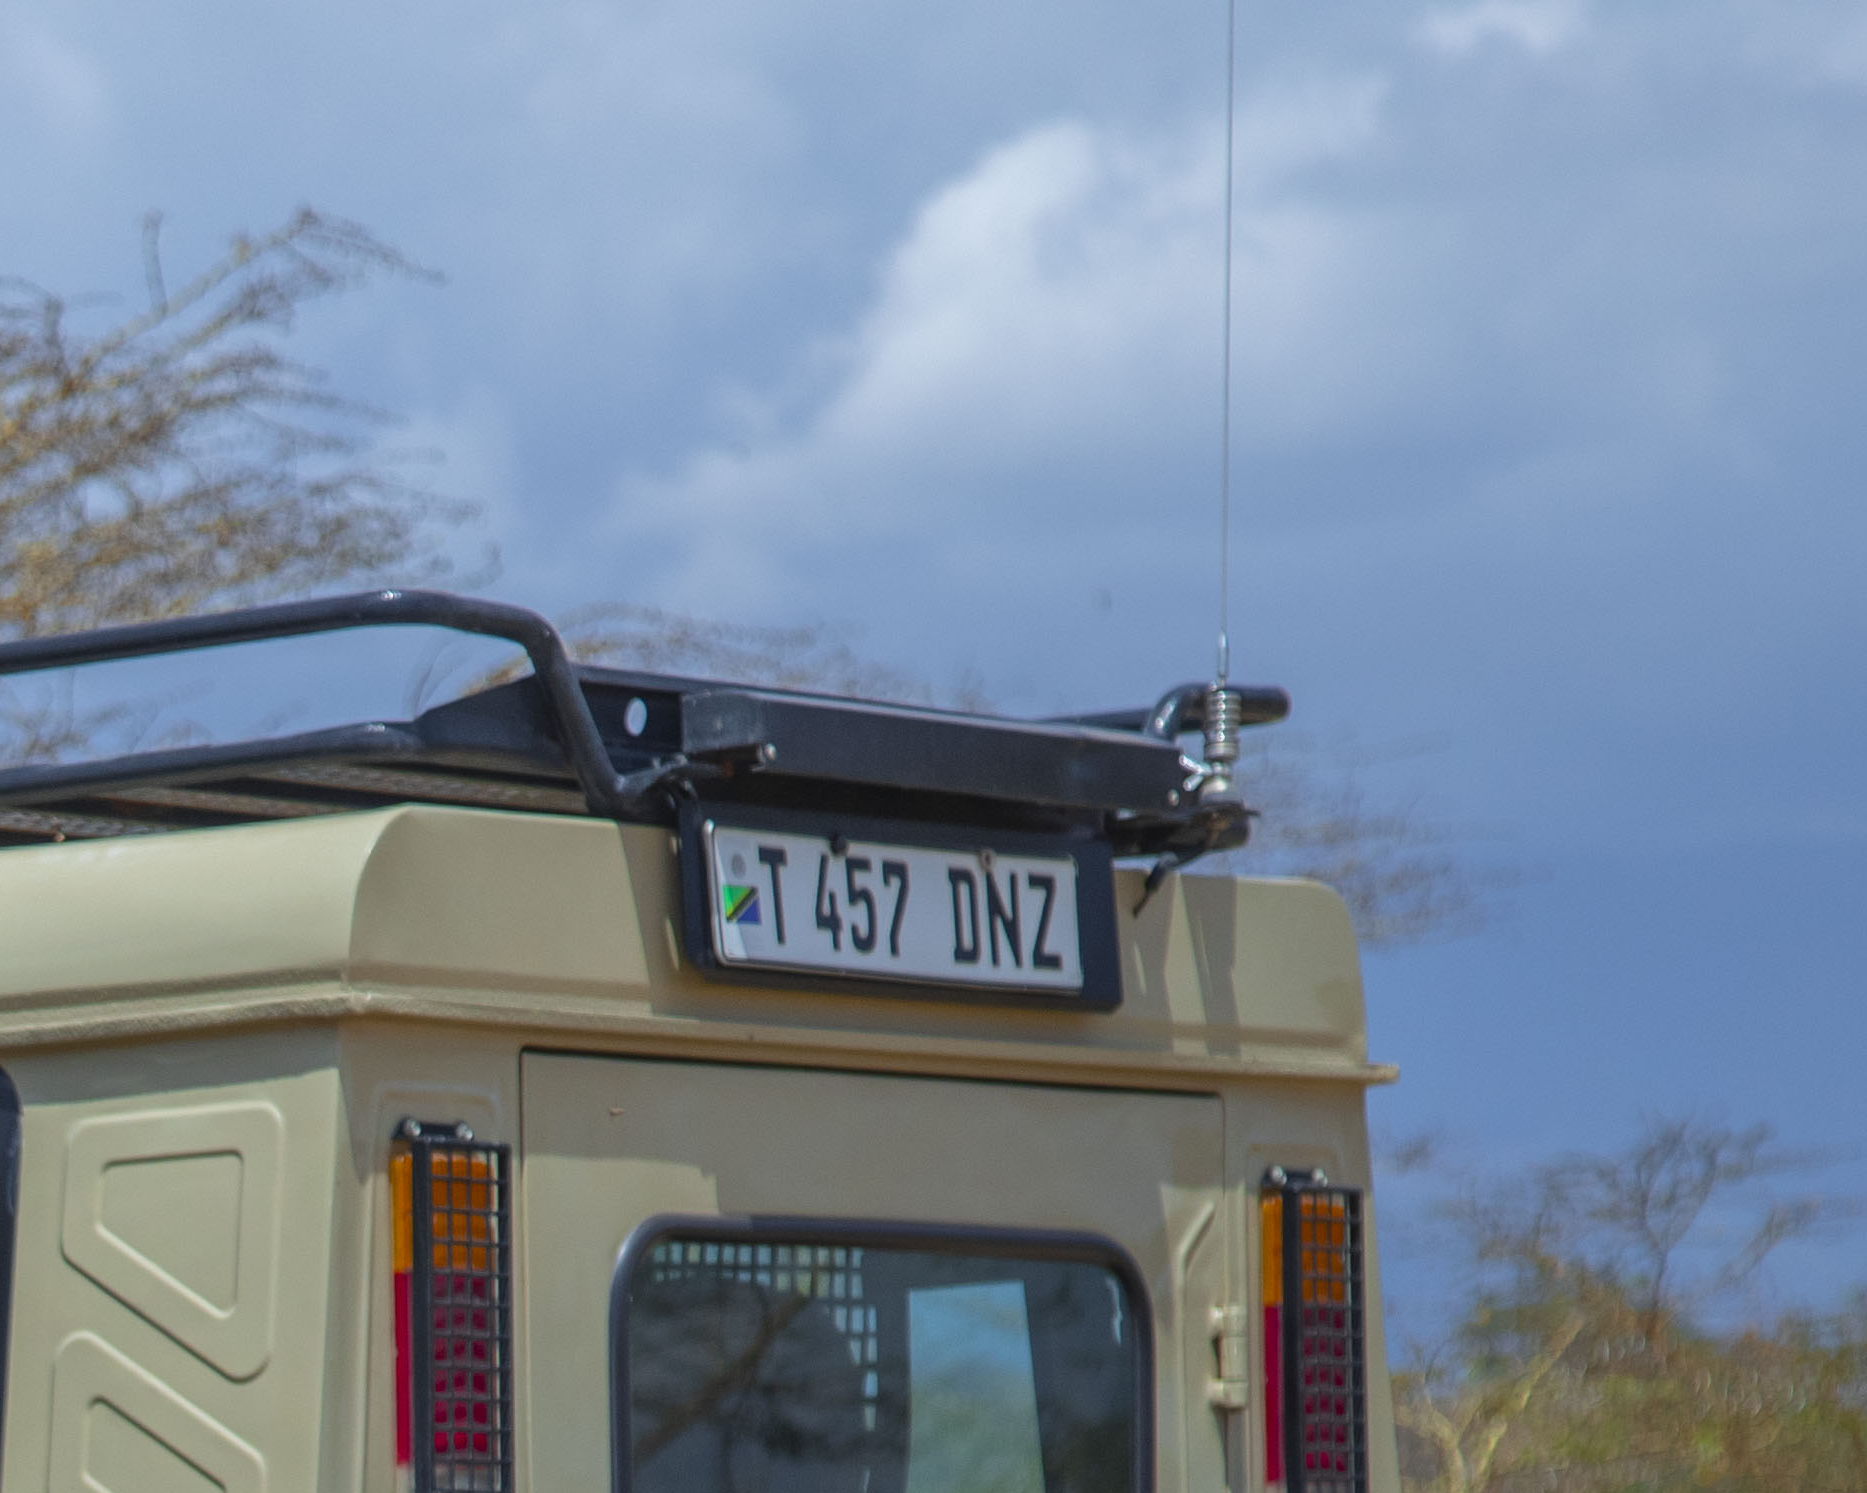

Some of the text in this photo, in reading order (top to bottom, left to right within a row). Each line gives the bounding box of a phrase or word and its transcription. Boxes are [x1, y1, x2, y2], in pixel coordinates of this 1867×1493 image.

[758, 845, 1064, 970] T 457 DNZ
